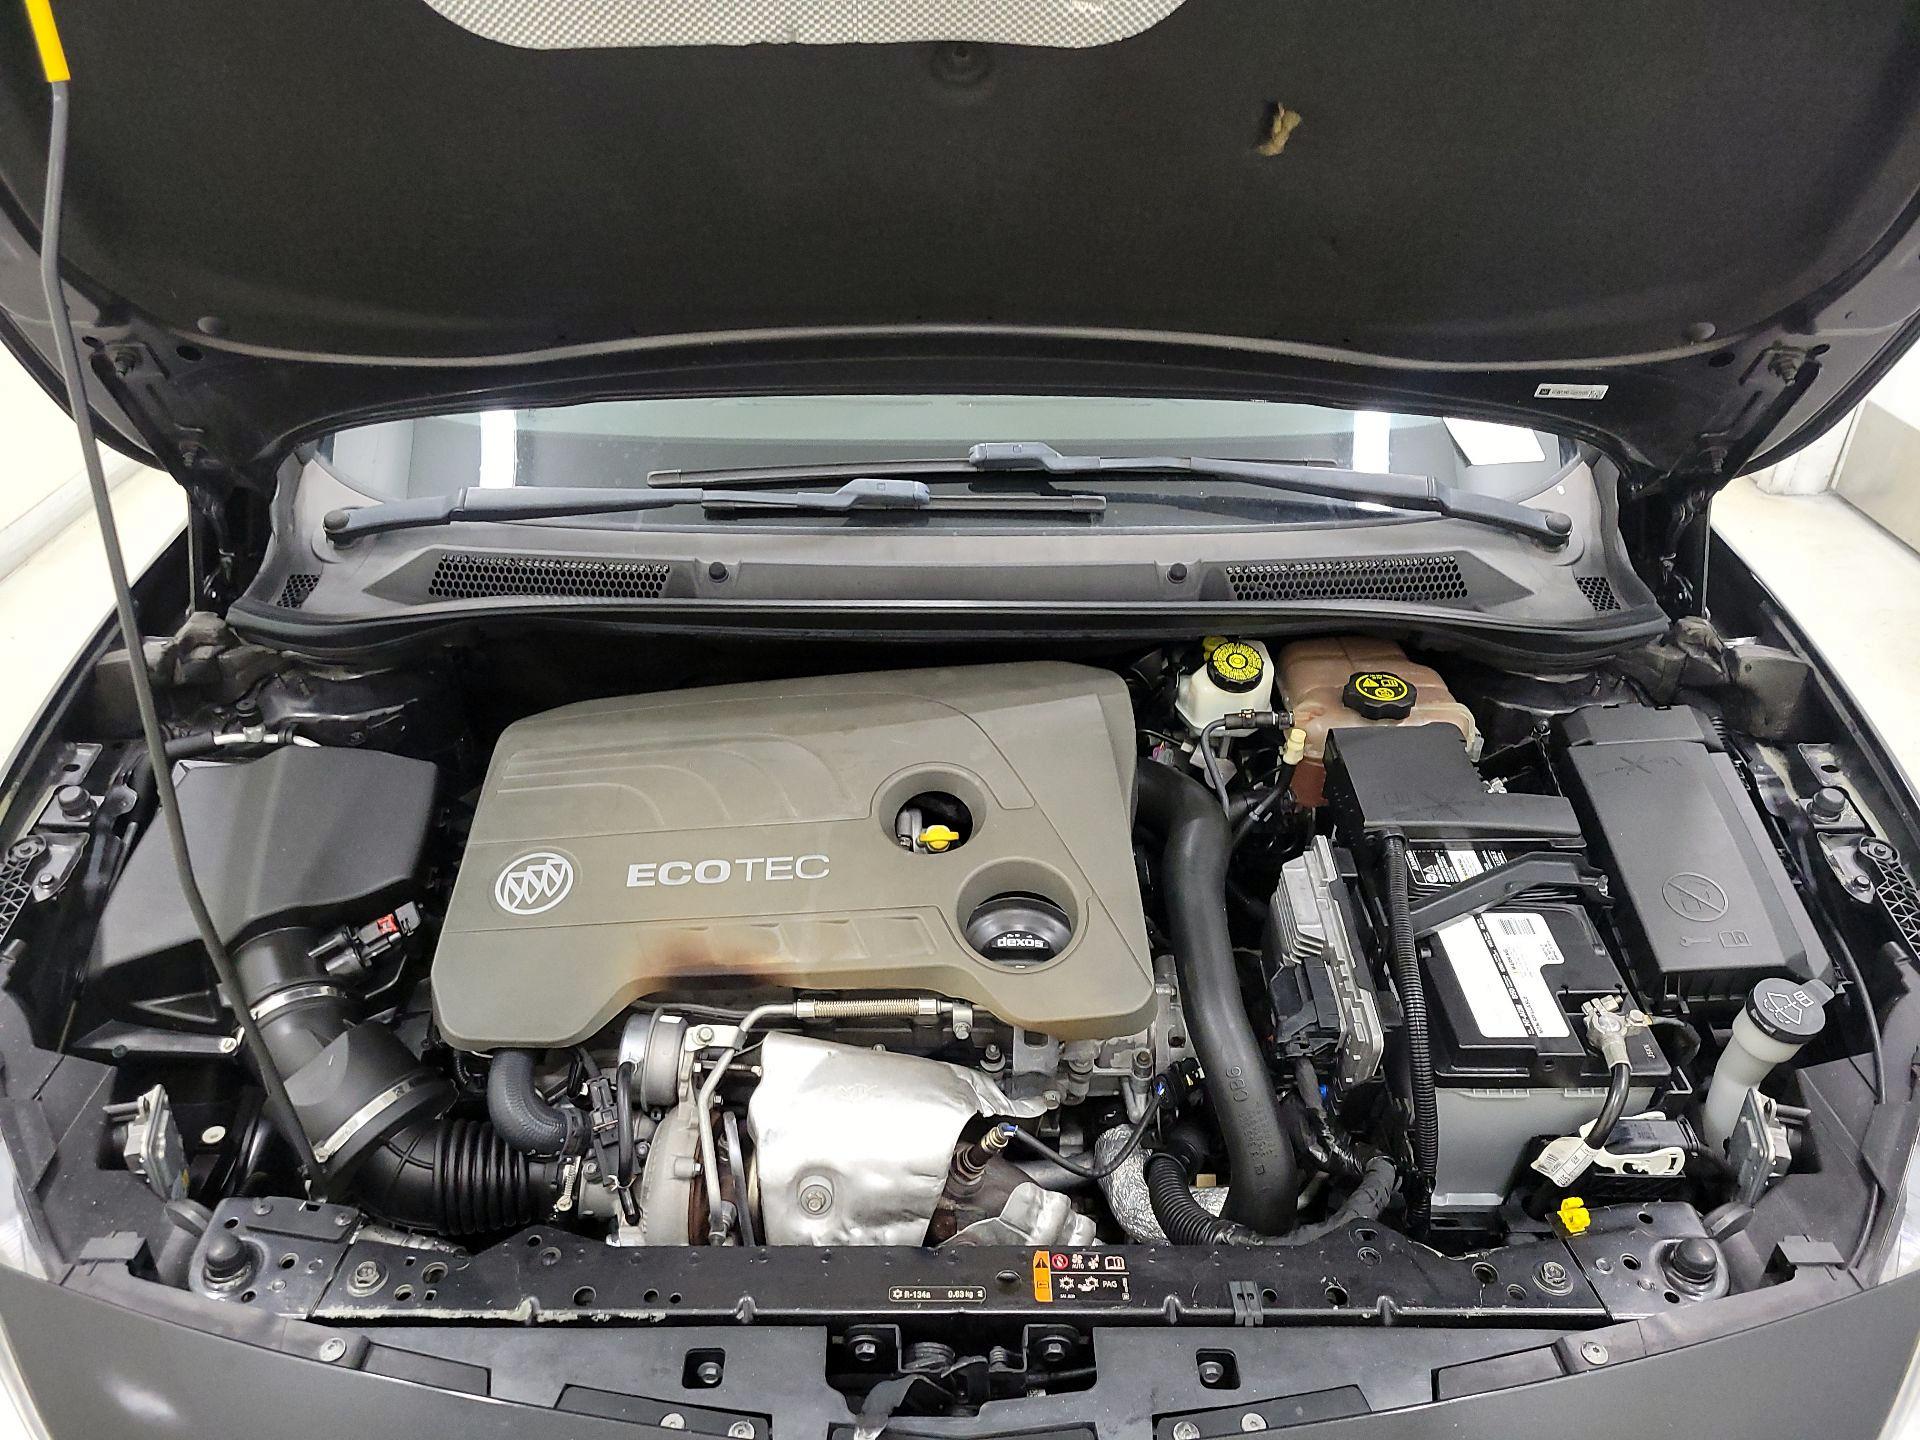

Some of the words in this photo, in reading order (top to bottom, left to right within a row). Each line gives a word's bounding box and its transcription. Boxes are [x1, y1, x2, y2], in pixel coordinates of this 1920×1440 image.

[626, 854, 830, 887] ECOTEC
[997, 936, 1044, 948] dexos
[1102, 1280, 1118, 1288] PAG
[904, 1290, 931, 1299] R-134a
[965, 1290, 974, 1299] kg
